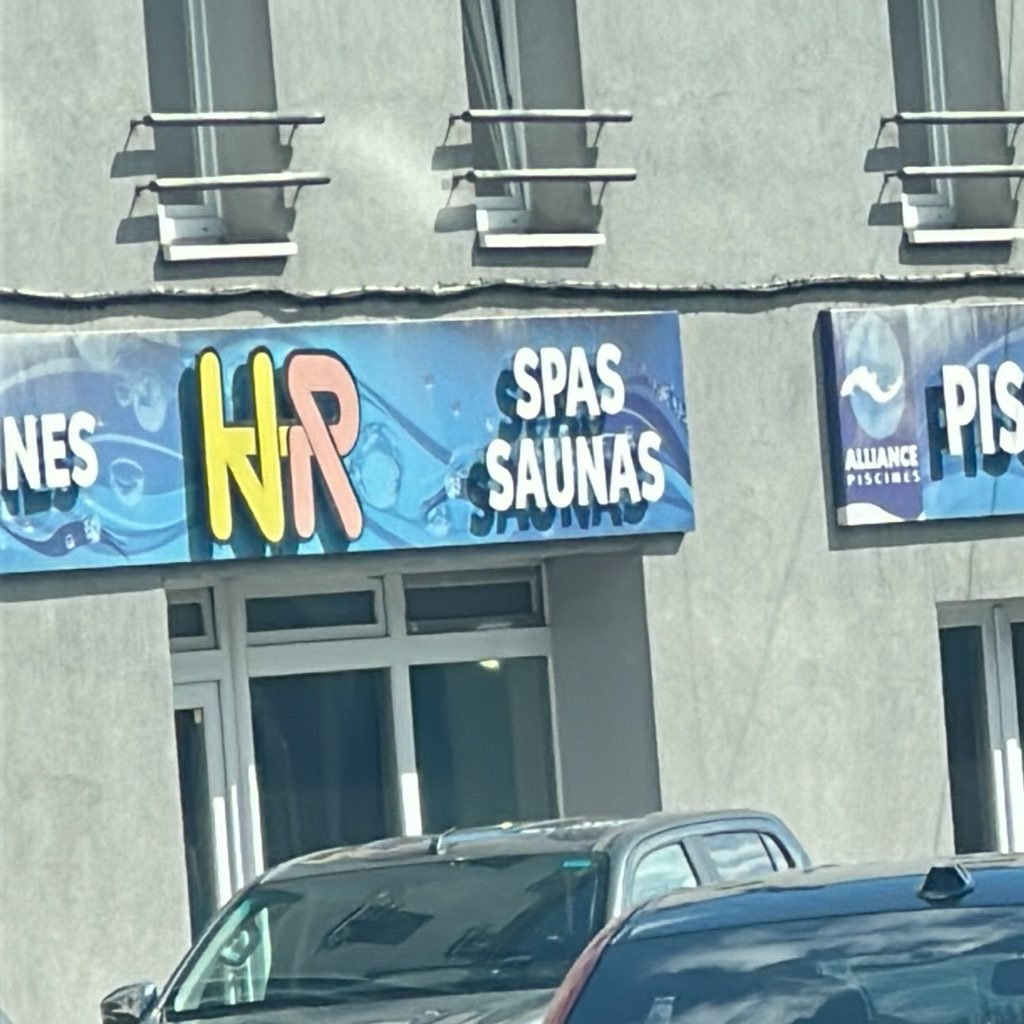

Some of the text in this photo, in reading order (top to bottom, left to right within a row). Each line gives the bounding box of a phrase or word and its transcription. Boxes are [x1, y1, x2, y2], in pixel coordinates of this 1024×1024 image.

[513, 343, 625, 420] SPAS
[0, 411, 98, 490] NES
[485, 431, 665, 511] SAUNAS
[845, 445, 918, 471] ALLIANCE
[847, 470, 920, 486] PISCINES
